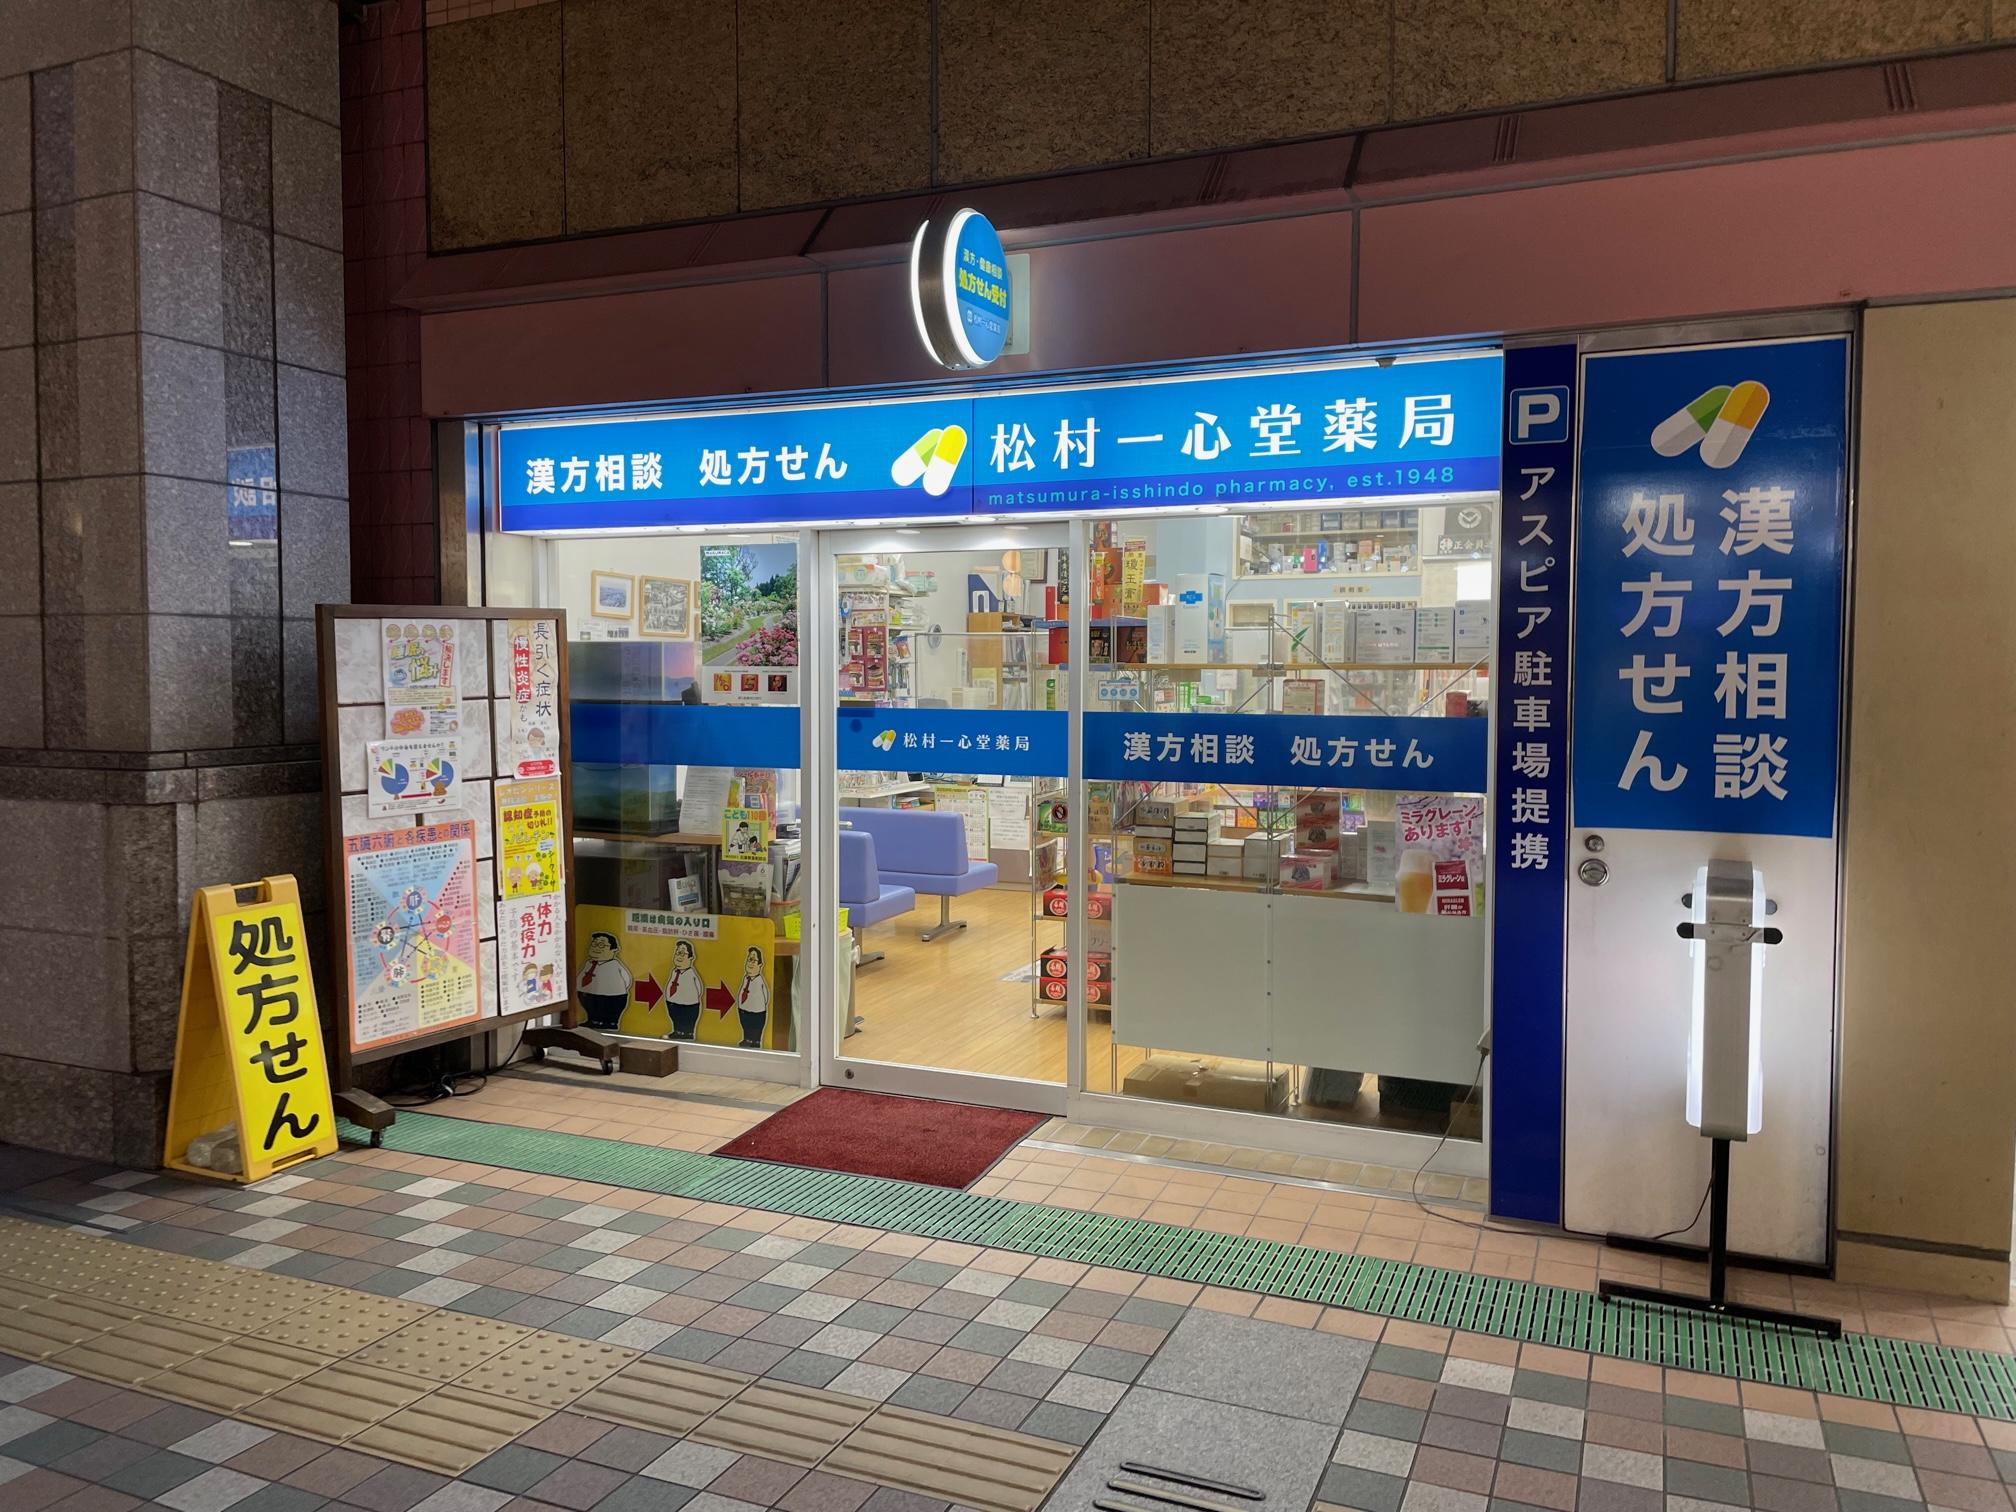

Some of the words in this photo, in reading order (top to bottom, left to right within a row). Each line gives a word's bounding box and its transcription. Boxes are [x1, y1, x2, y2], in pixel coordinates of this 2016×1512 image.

[959, 267, 1007, 309] 処方せん受付
[989, 394, 1456, 474] 松村一心堂薬局
[1516, 393, 1561, 439] P
[526, 451, 663, 495] 漢方相談
[699, 442, 848, 487] 処方せん
[988, 482, 1204, 505] matsumura-isshindo
[1215, 473, 1335, 498] pharmacy,
[1346, 466, 1456, 489] est.1948
[1617, 491, 1695, 792] 処方せん
[1713, 486, 1796, 801] 漢方相談
[514, 635, 532, 721] 慢性炎症かも
[533, 622, 552, 718] 長引く症状
[1511, 466, 1556, 871] アスピア駐車場提携
[903, 732, 1030, 752] 松村一心堂薬局
[1123, 732, 1255, 765] 漢方相談
[1290, 735, 1435, 768] 処方せん
[724, 810, 767, 822] こども110番
[1401, 804, 1477, 825] ミラグレーン
[1404, 820, 1472, 842] あります!
[228, 916, 320, 1150] 処方せん
